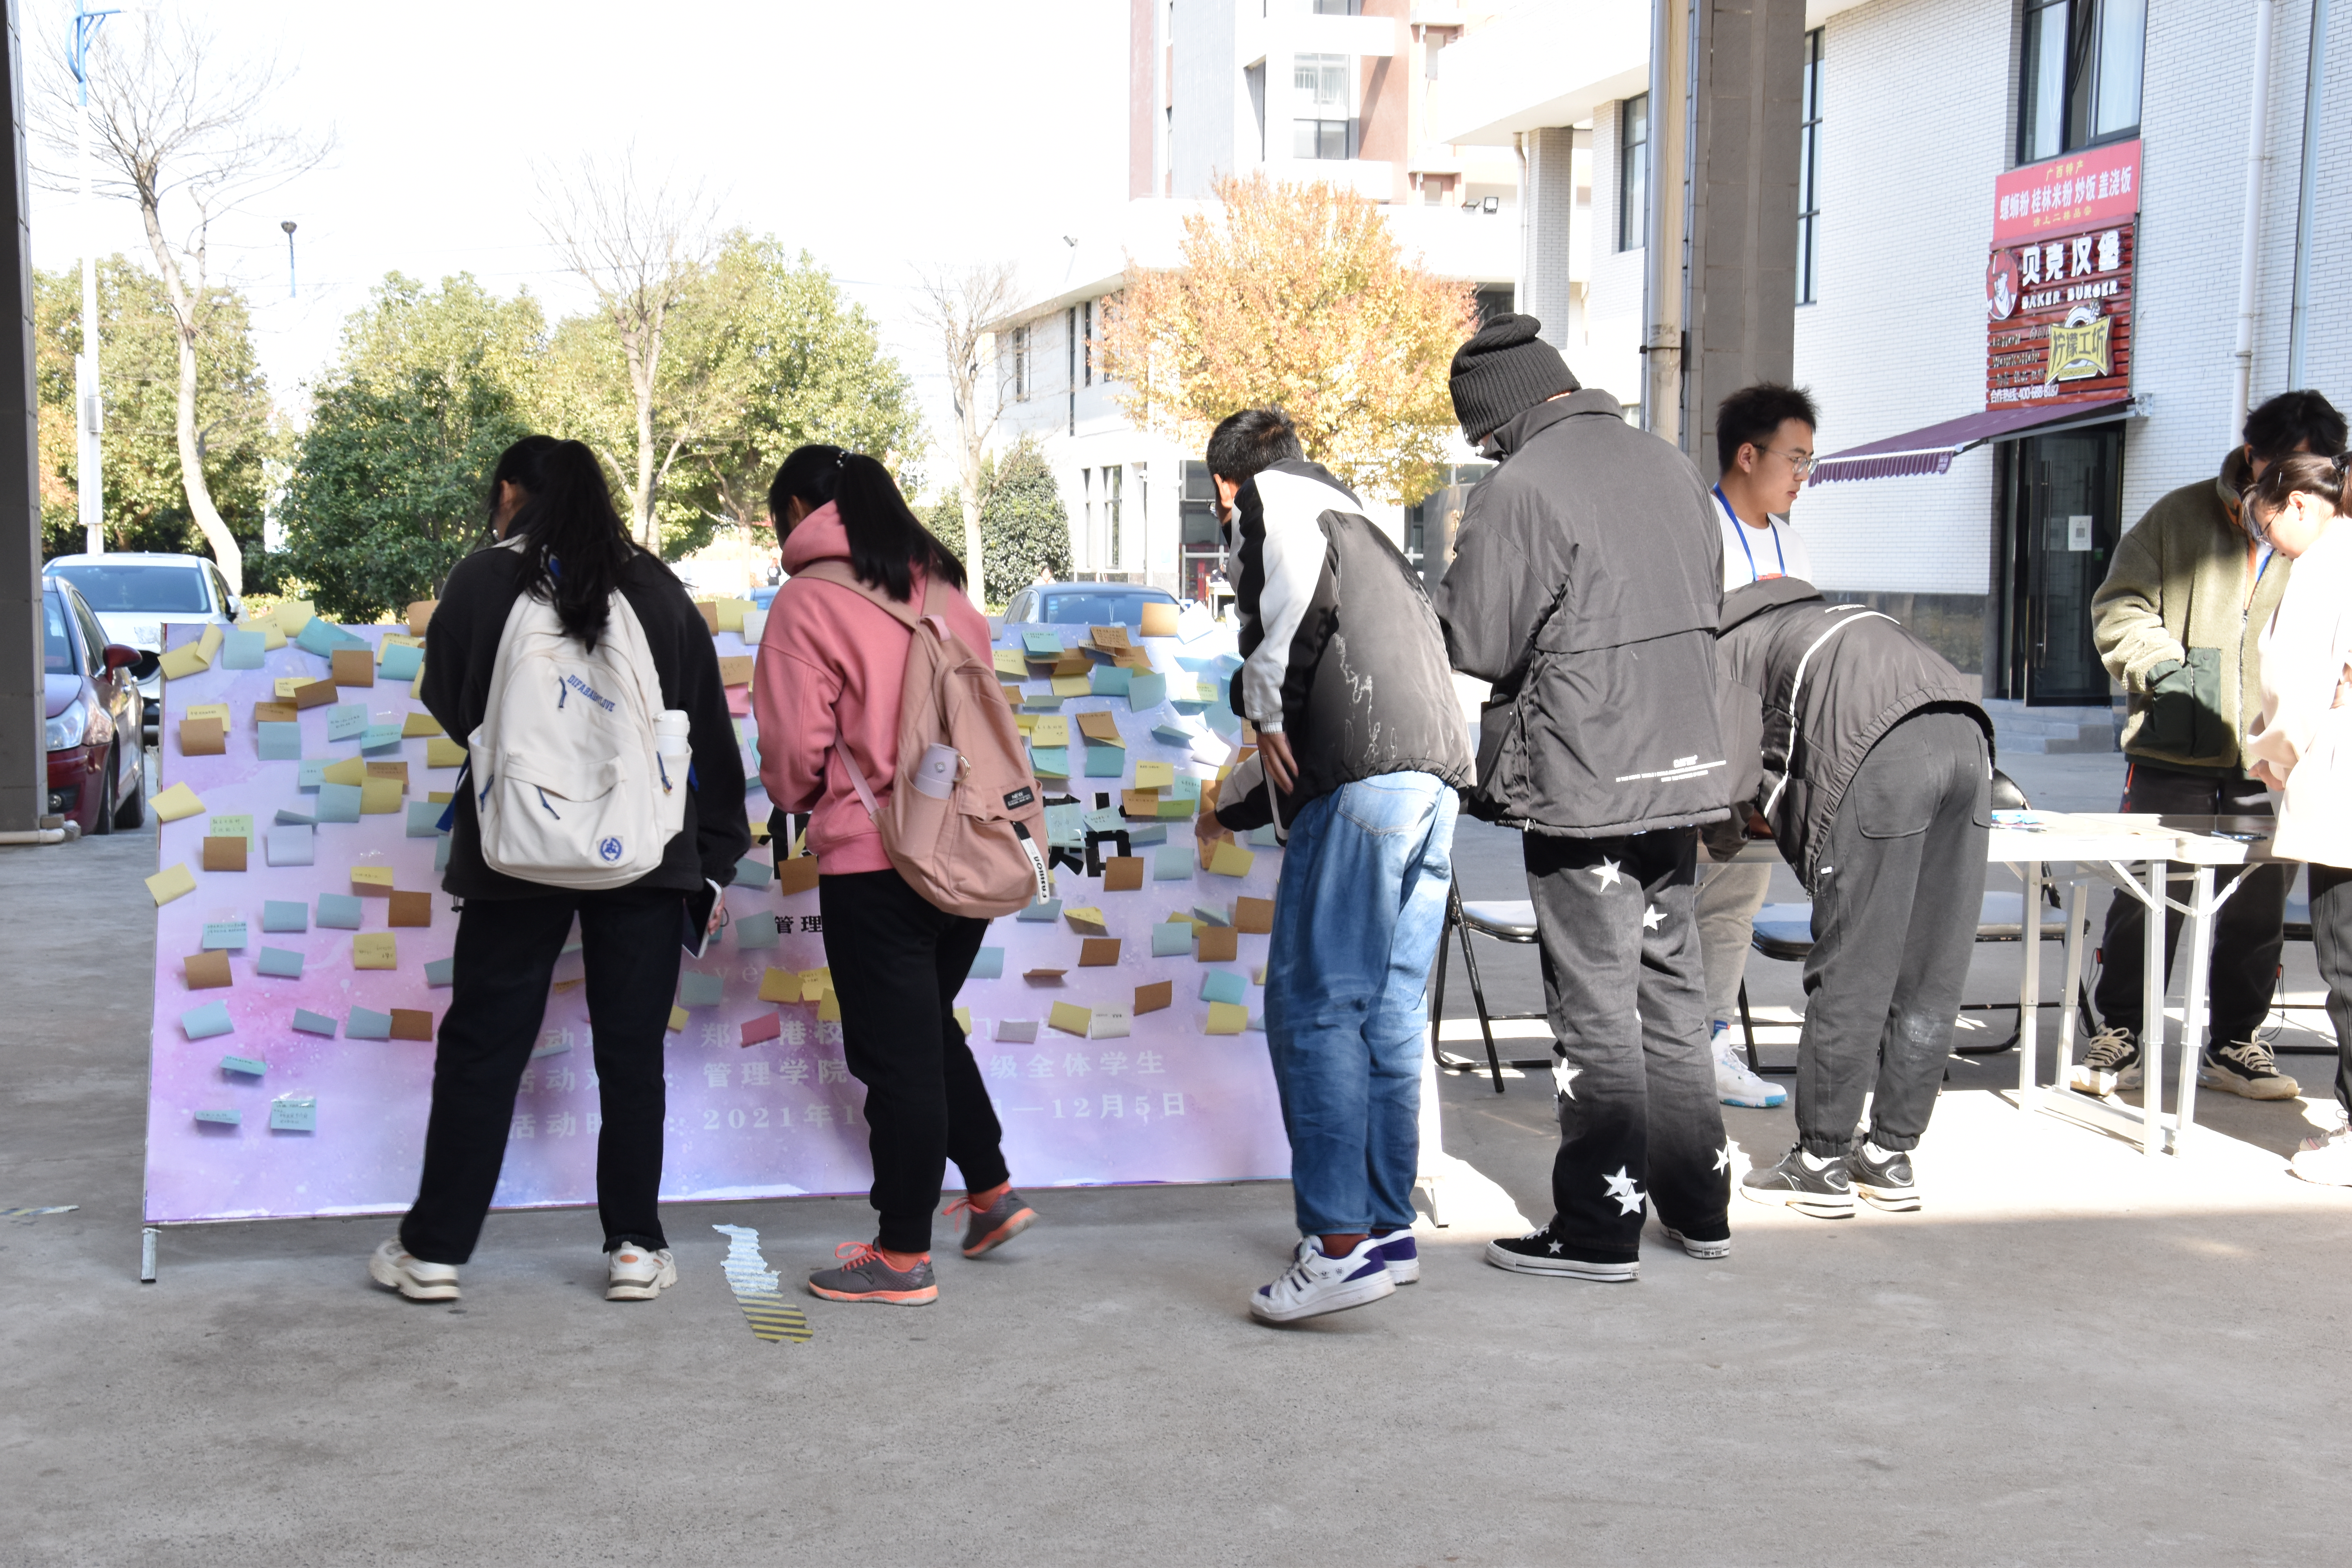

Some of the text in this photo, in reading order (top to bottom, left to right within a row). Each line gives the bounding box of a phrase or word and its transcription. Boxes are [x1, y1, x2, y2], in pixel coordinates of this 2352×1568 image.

[2046, 160, 2083, 181] 广西特产
[1999, 165, 2132, 221] 螺蛳粉 桂林米粉 炒饭 盖浇饭
[2022, 230, 2119, 287] 贝克汉堡
[2022, 280, 2118, 310] BAKER BURGER
[1993, 352, 2040, 368] WORKSHOP
[2051, 325, 2105, 373] 柠檬工坊
[990, 1050, 1166, 1080] 级全体学生
